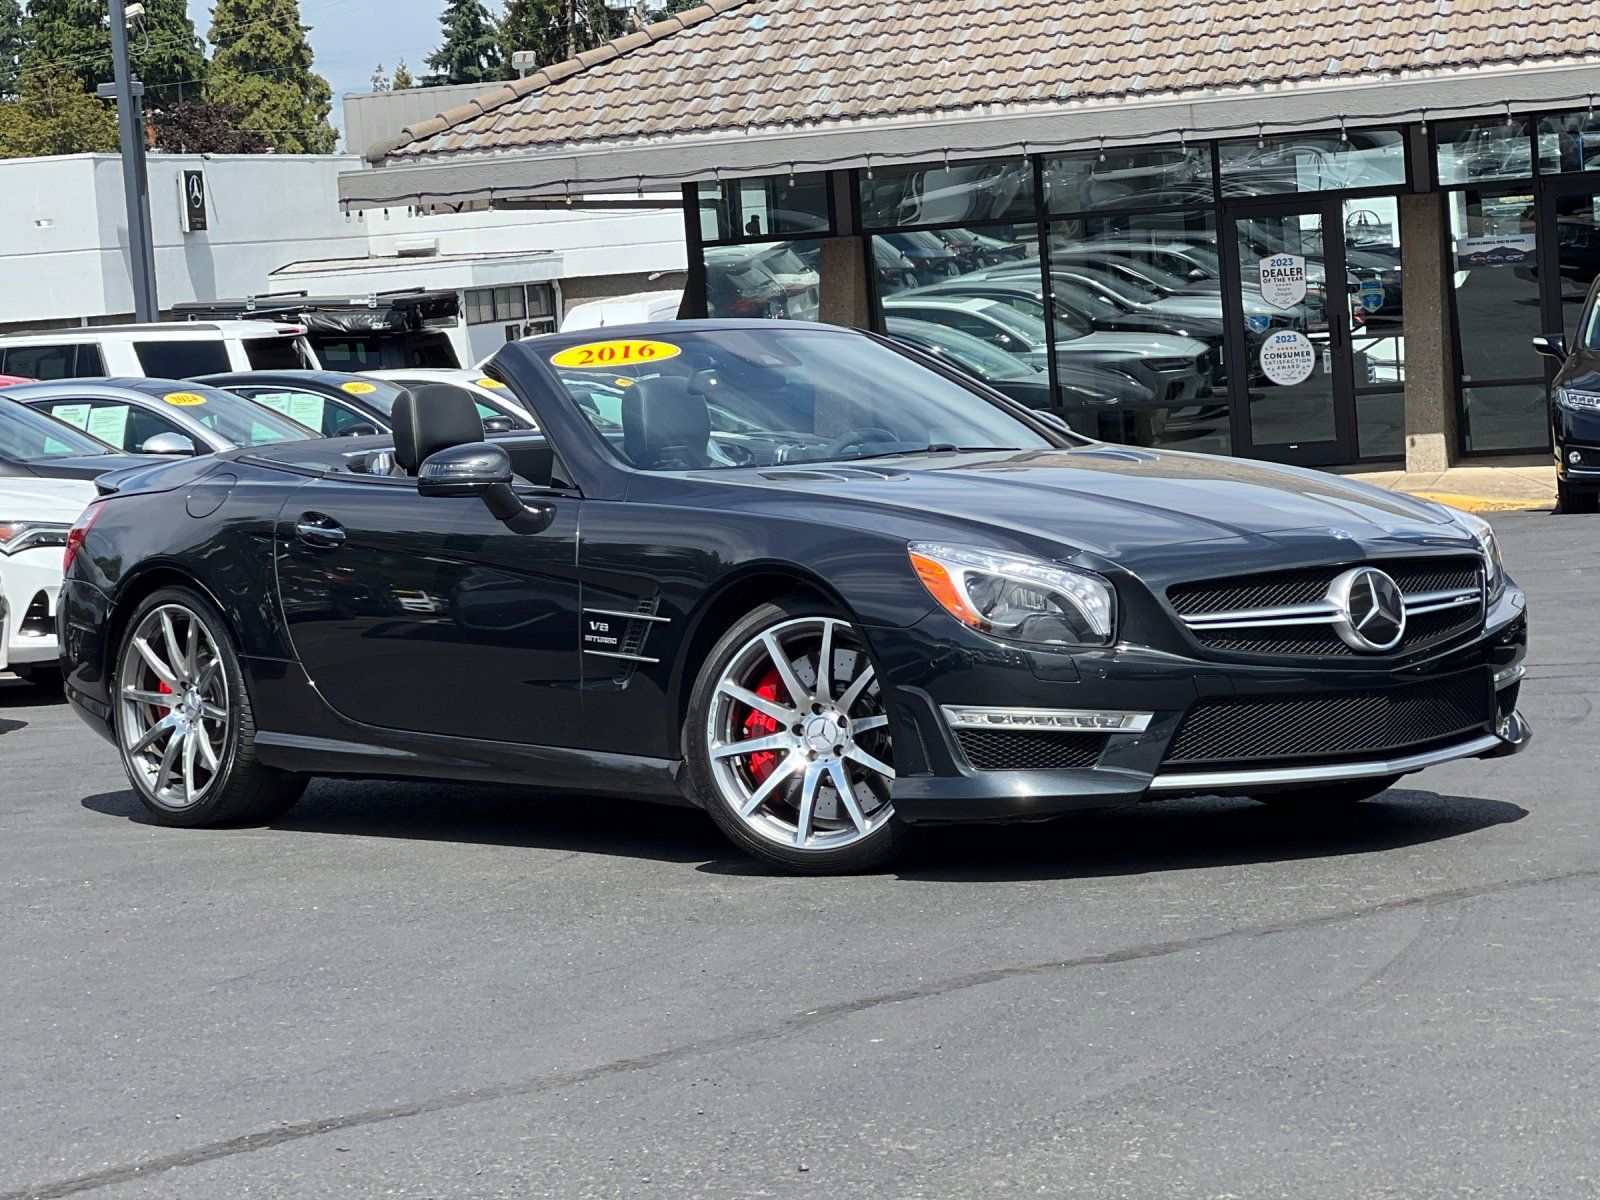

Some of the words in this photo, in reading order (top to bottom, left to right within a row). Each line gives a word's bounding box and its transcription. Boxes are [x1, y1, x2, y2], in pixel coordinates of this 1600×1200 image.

[1270, 257, 1293, 266] 2023
[1262, 267, 1303, 278] DEALER
[1275, 335, 1297, 343] 2023
[578, 344, 655, 365] 2016
[1263, 350, 1311, 360] CONSUMER
[1264, 358, 1312, 366] SATISFACTION
[589, 621, 609, 631] V8
